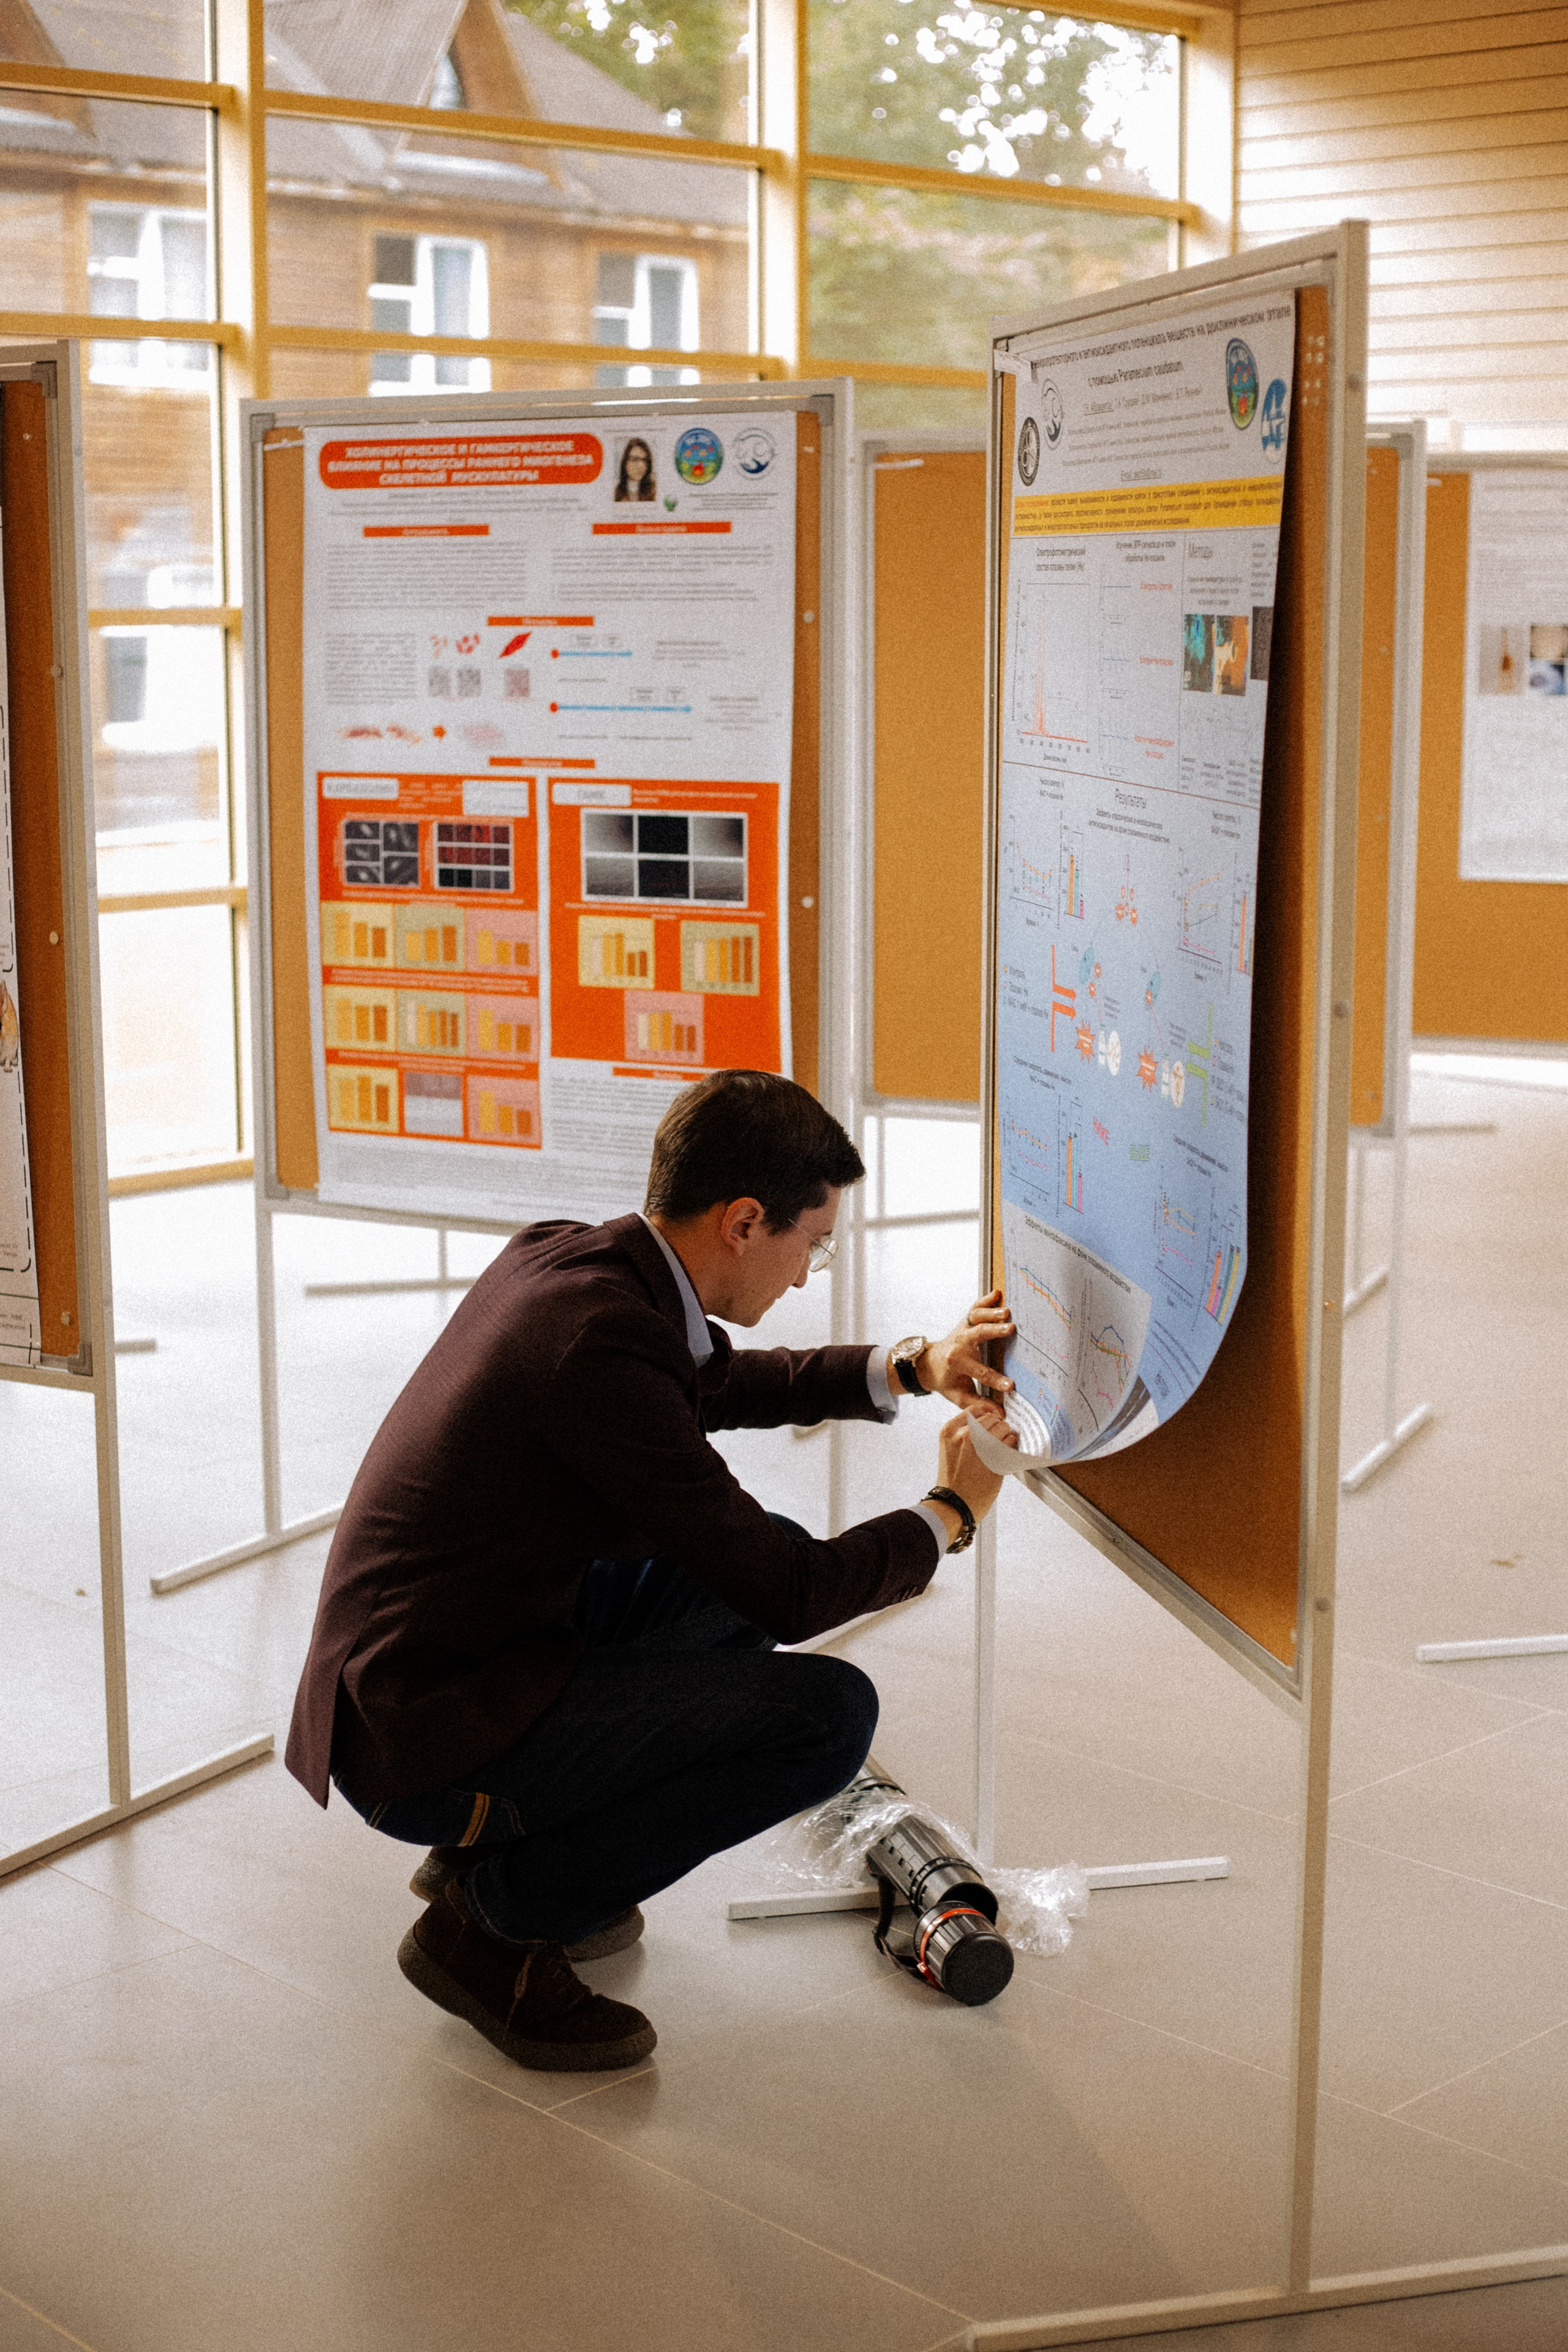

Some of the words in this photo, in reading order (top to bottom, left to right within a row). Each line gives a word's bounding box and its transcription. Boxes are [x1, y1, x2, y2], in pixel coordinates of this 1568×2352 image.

[1168, 326, 1196, 342] веществ
[1197, 325, 1206, 335] на
[1207, 311, 1264, 335] доклиническом
[1266, 305, 1292, 321] этапе
[1118, 366, 1154, 385] Paramecium
[459, 443, 467, 454] И
[328, 459, 382, 473] ВЛИЯНИЕ
[384, 459, 401, 472] НА
[402, 458, 466, 471] ПРОЦЕССЫ
[467, 456, 521, 469] РАННЕГО
[451, 469, 539, 484] МУСКУЛАТУРЫ
[1188, 543, 1213, 559] Методы
[1115, 788, 1147, 809] Результаты
